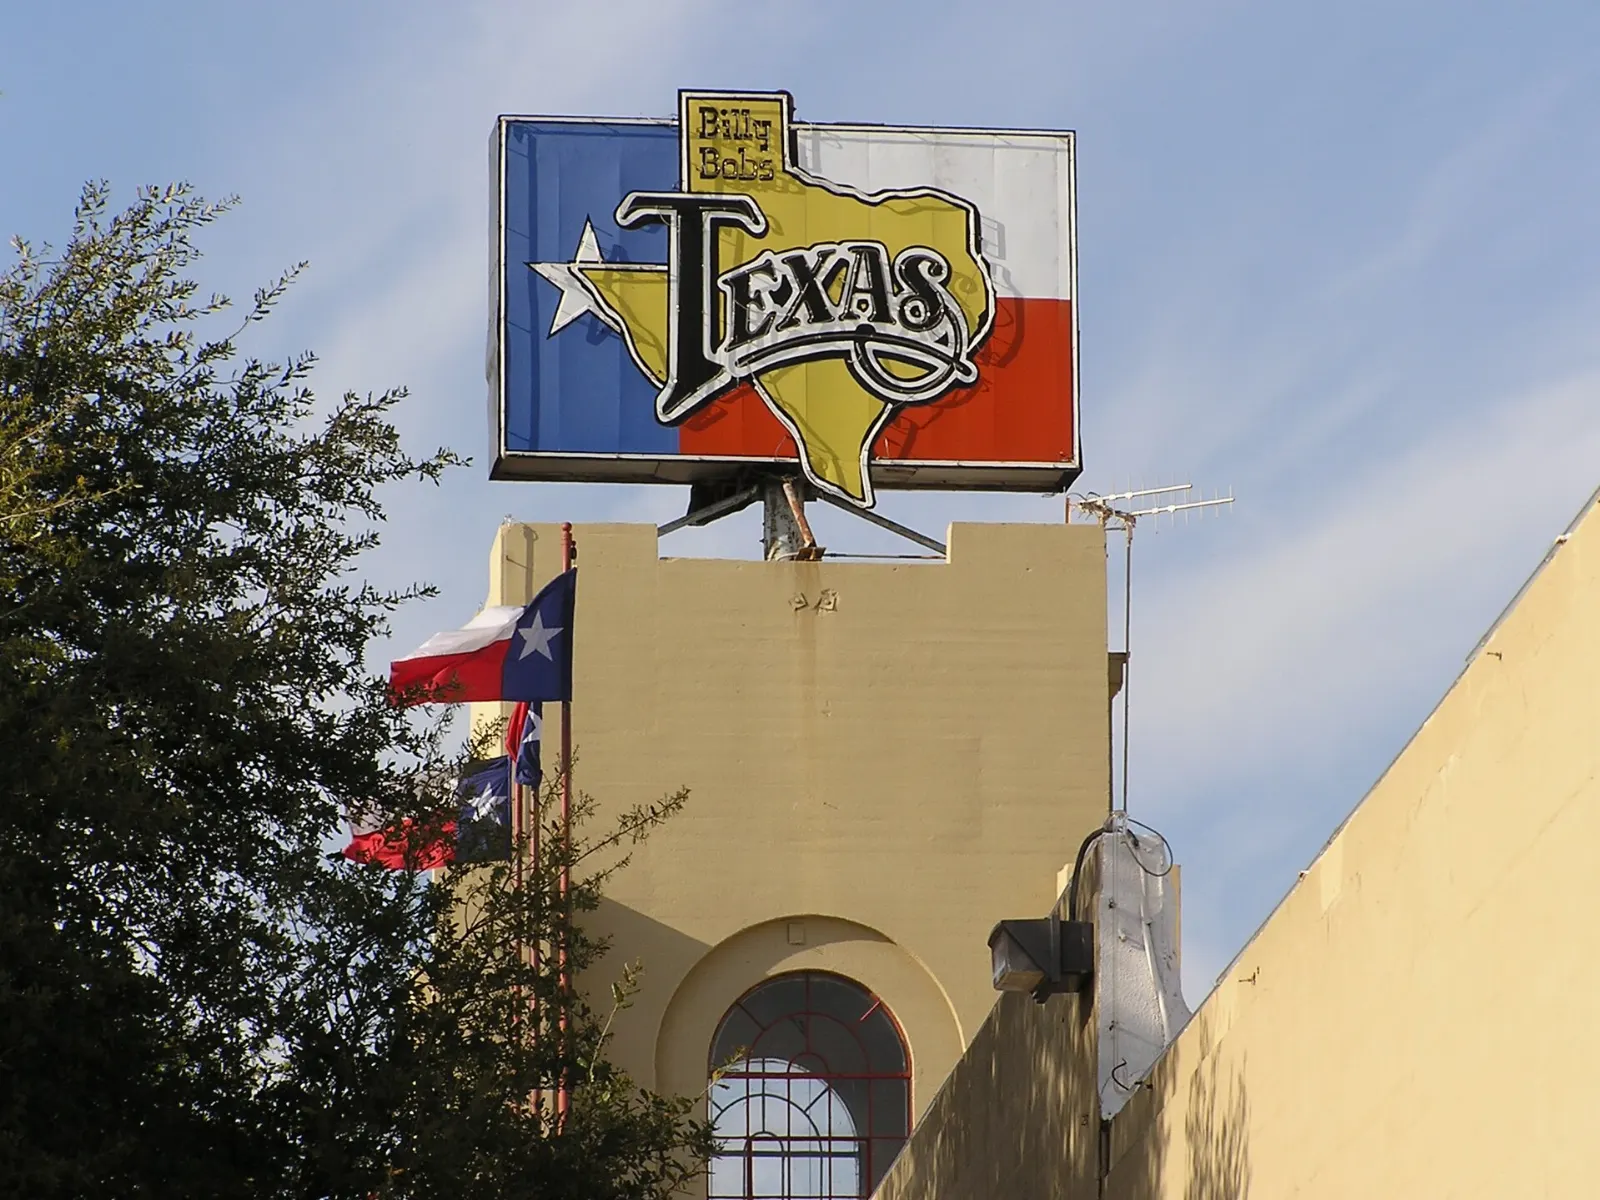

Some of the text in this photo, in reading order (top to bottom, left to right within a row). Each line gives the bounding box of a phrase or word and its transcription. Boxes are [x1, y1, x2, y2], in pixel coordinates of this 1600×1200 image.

[698, 106, 772, 152] Billy
[698, 146, 775, 181] Bobs
[615, 191, 978, 423] TEXAS
